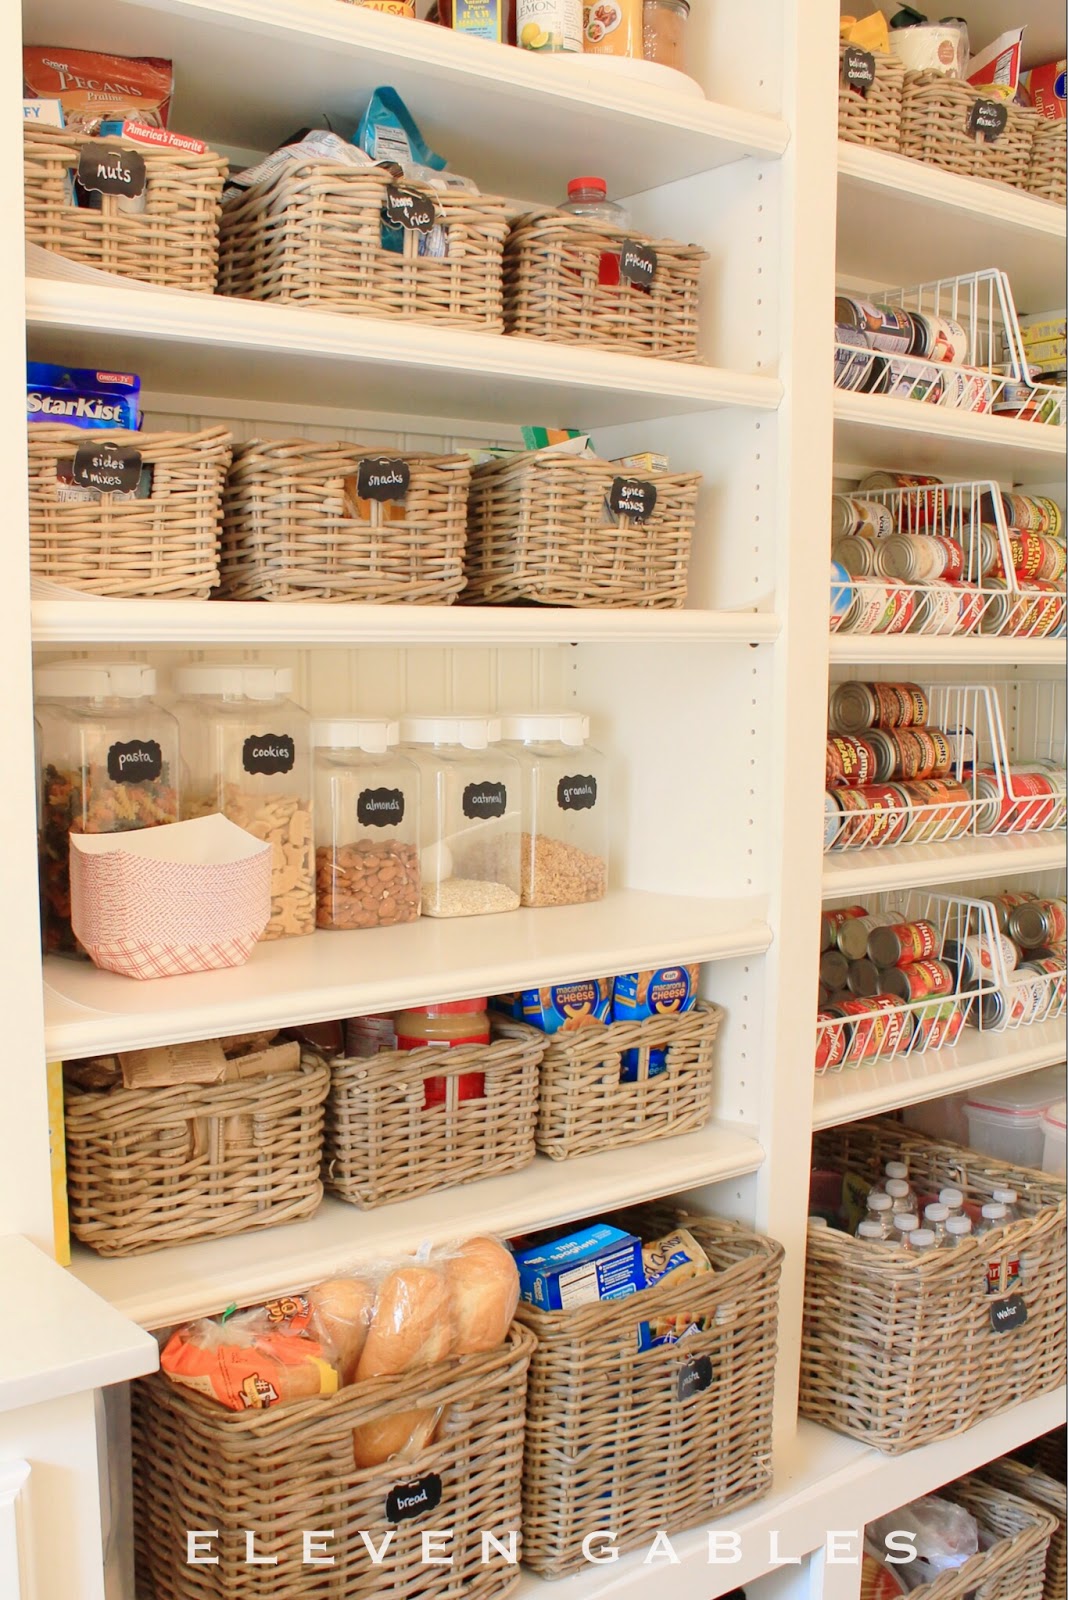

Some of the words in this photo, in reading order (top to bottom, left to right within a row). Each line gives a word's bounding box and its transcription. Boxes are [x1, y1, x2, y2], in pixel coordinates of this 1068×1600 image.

[58, 70, 143, 97] PECANS
[87, 91, 124, 102] Praline
[126, 122, 169, 142] America's
[168, 135, 203, 153] Favorite
[97, 160, 132, 184] nuts
[409, 211, 431, 227] rice
[624, 252, 653, 274] popcorn
[27, 392, 125, 422] StarKist
[92, 454, 125, 470] sides
[90, 472, 122, 486] mixes
[368, 470, 404, 487] snacks
[621, 486, 645, 499] spice
[618, 499, 645, 513] mixes
[1011, 539, 1019, 569] Bean
[913, 692, 925, 724] BUSH'S
[252, 745, 290, 760] cookies
[833, 738, 853, 774] BEANS
[933, 734, 947, 765] BUSH'S
[118, 749, 154, 771] pasta
[472, 791, 503, 805] oatmeal
[563, 785, 593, 803] granola
[365, 798, 400, 812] almonds
[916, 921, 933, 957] Hunt's
[556, 982, 589, 994] macaroni
[652, 983, 681, 992] macaroni
[549, 1238, 599, 1262] Spaghetti
[555, 1240, 579, 1253] Thin
[396, 1488, 428, 1511] bread
